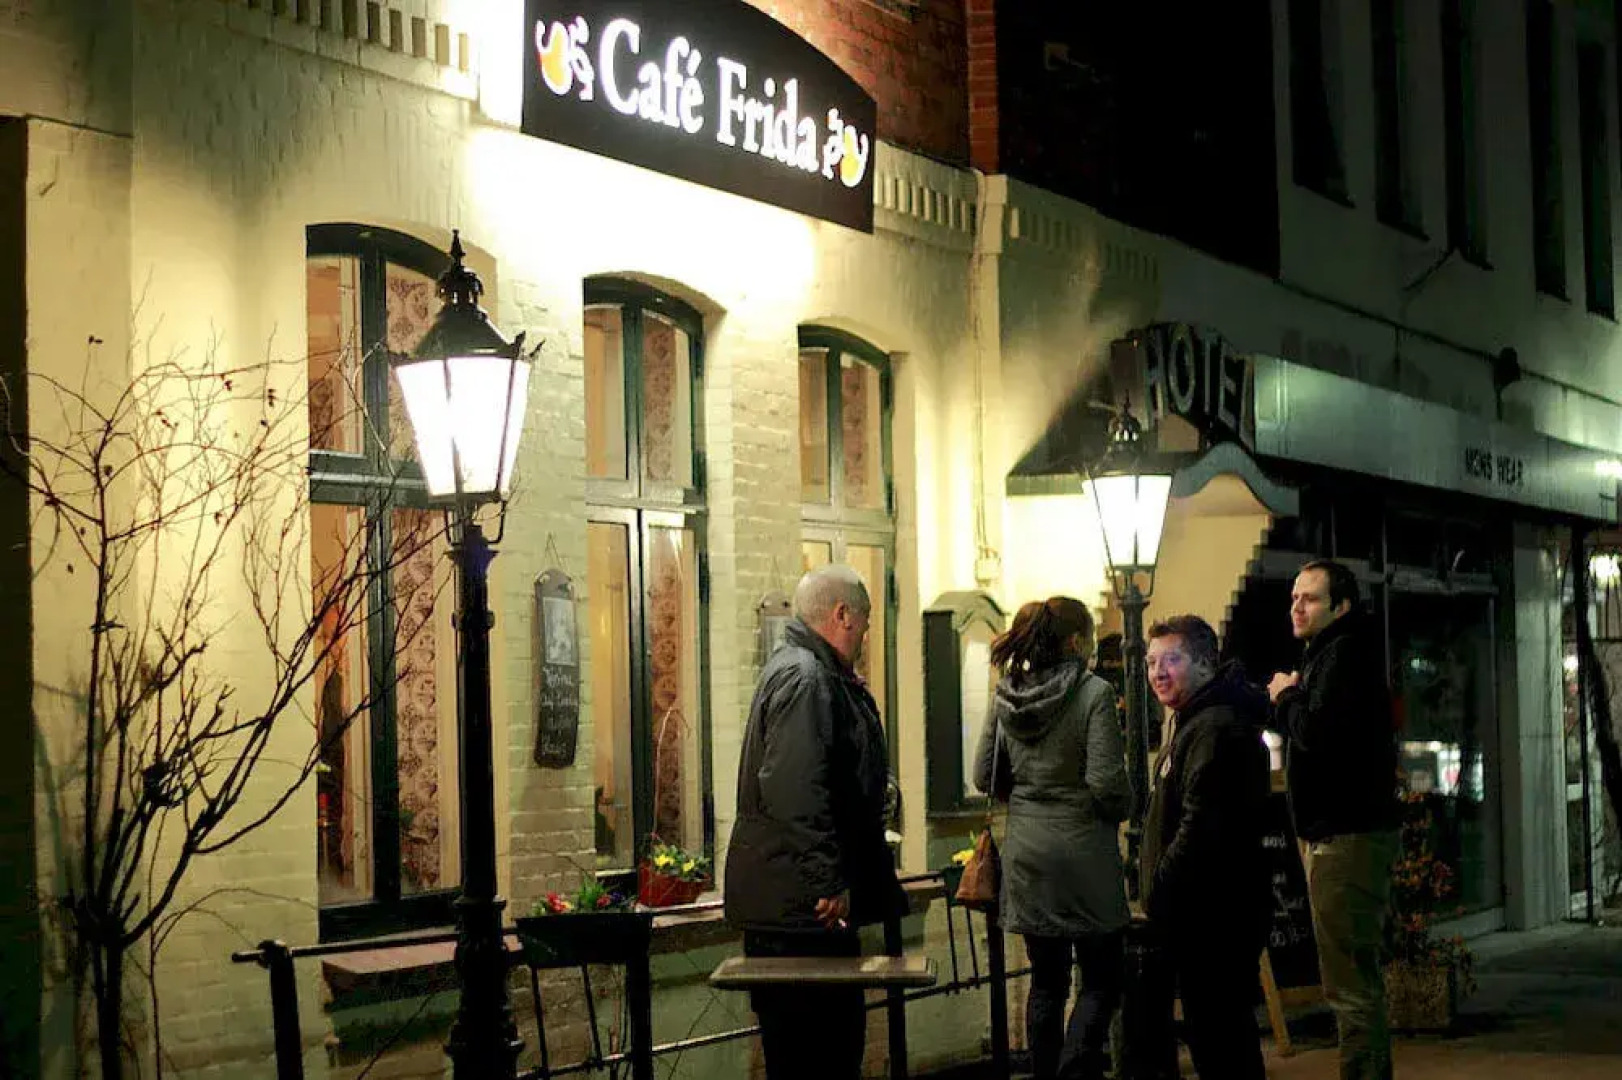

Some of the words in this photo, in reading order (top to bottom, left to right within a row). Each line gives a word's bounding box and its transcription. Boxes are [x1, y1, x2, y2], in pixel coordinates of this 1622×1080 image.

[600, 18, 704, 133] Café
[717, 57, 819, 173] Frida
[1139, 323, 1254, 452] HOTEL
